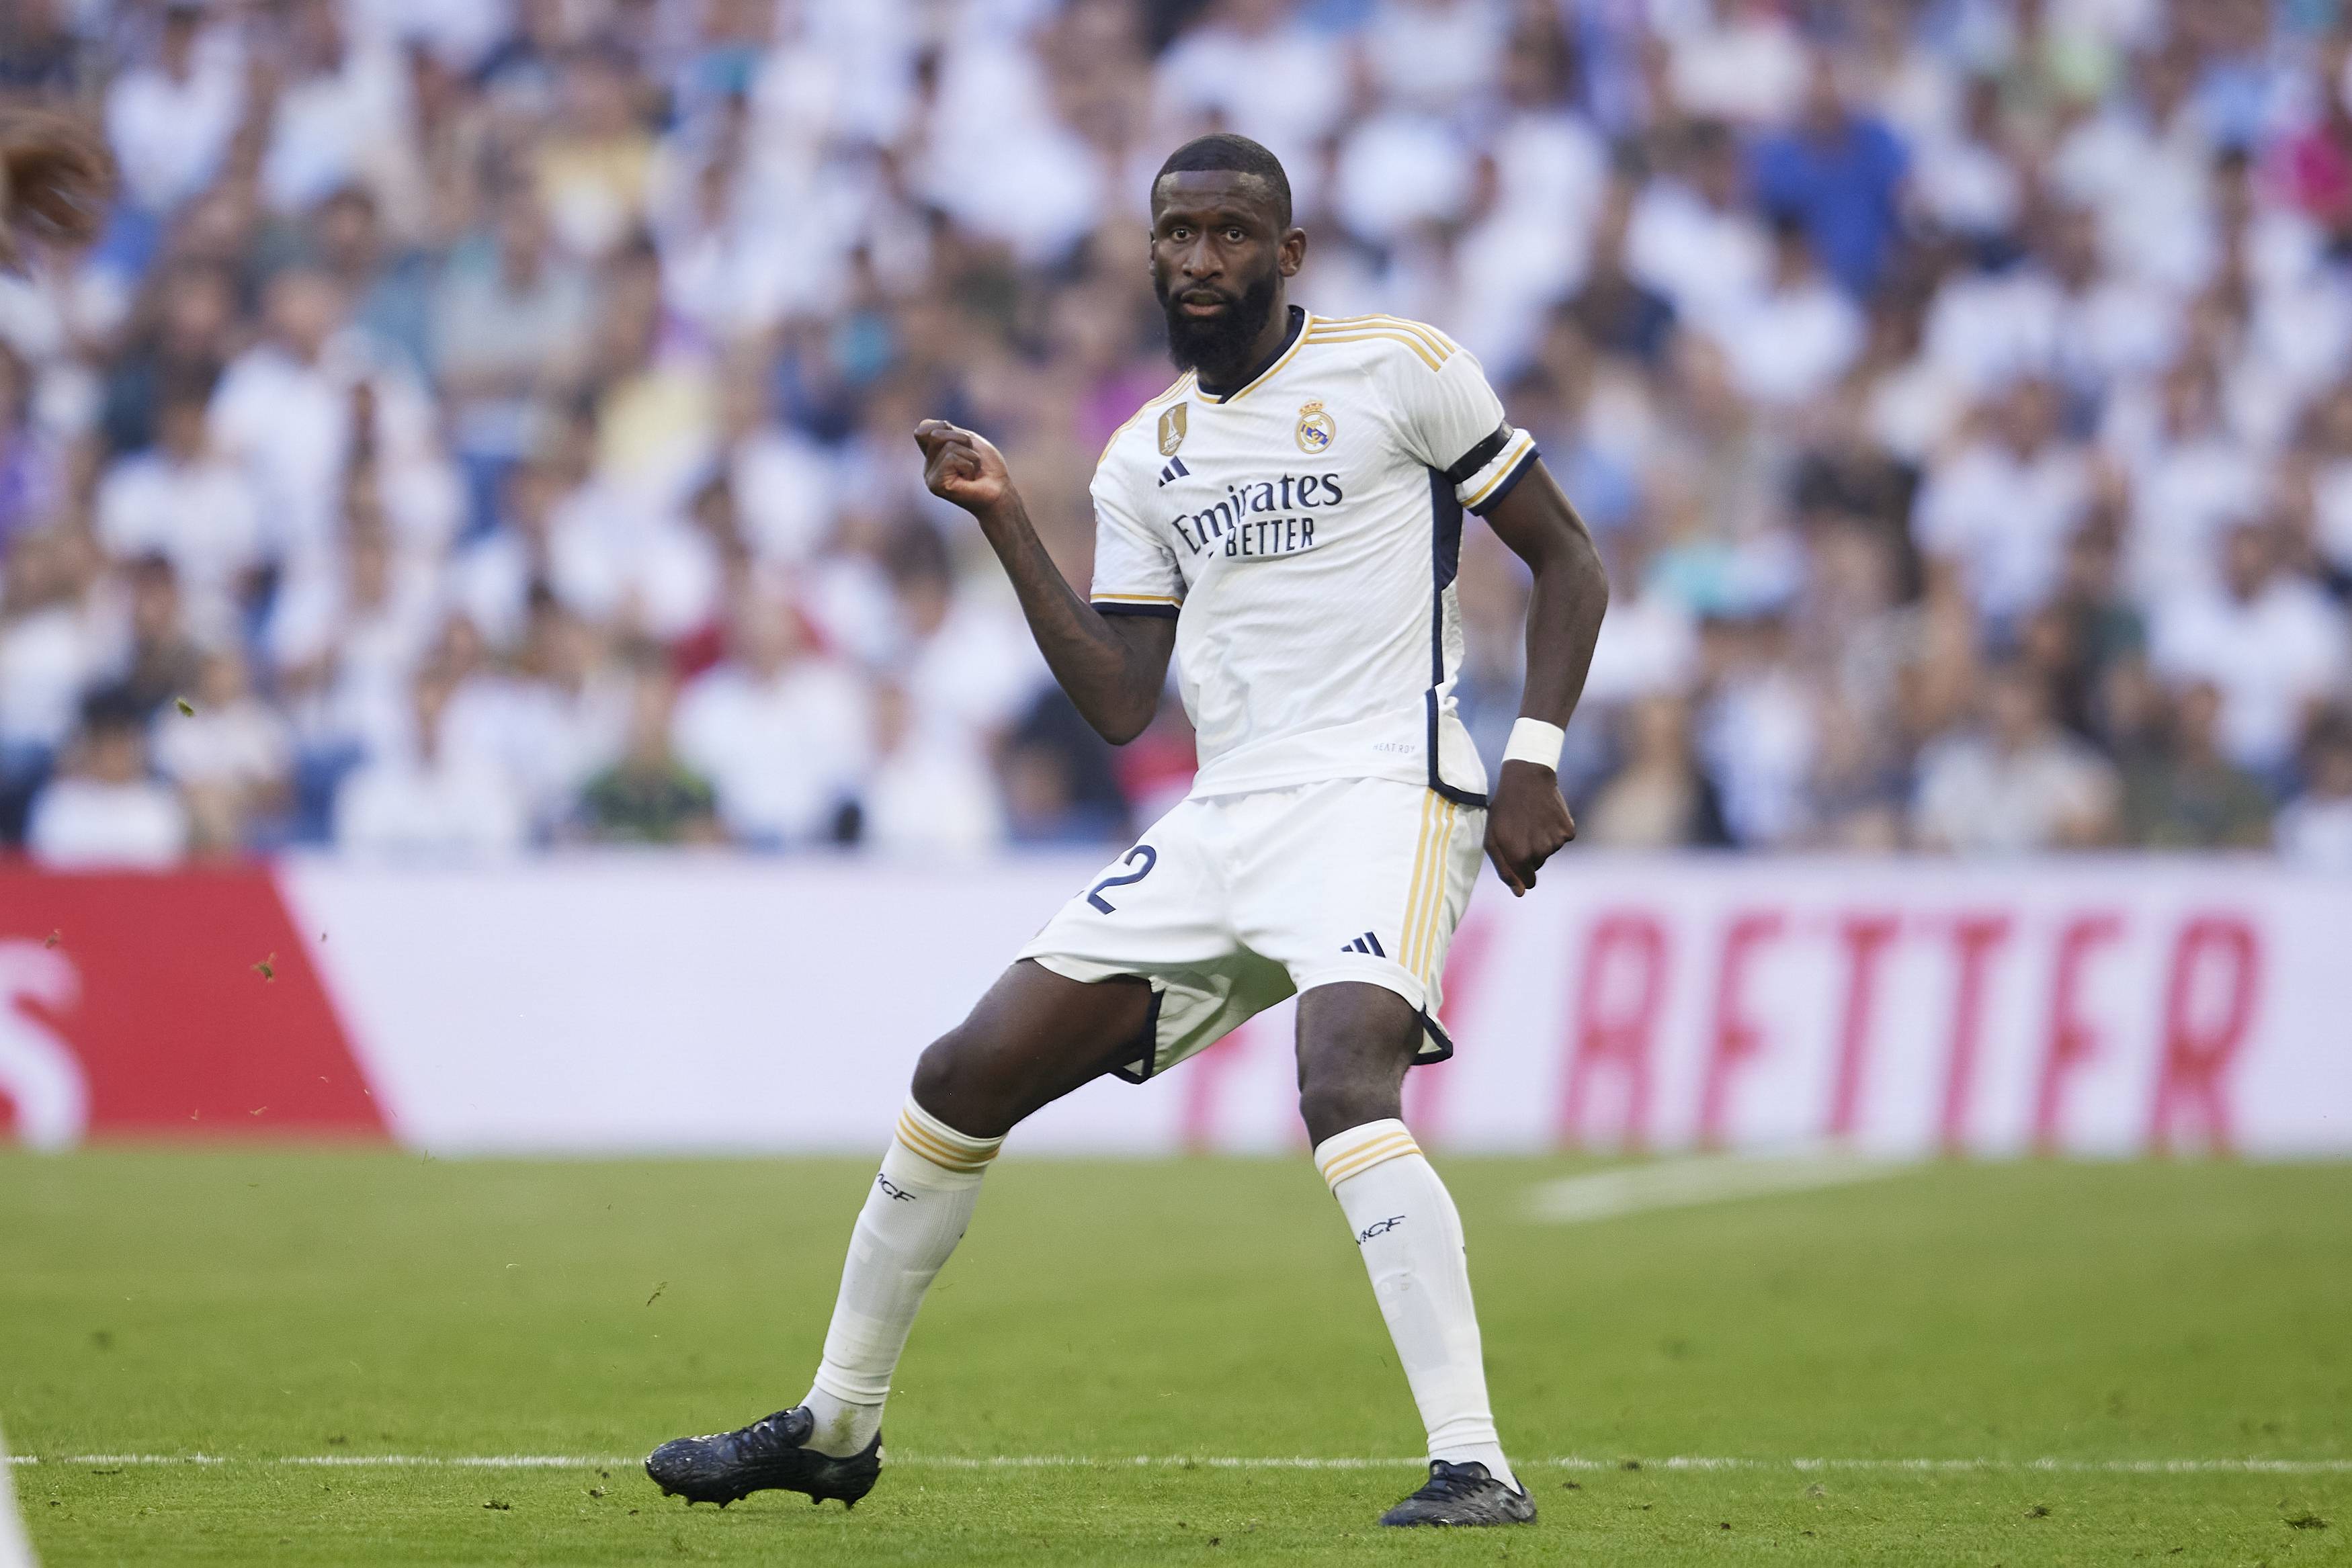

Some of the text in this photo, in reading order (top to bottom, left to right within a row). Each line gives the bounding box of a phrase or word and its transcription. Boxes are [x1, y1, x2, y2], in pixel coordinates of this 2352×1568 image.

[1172, 472, 1343, 554] Emirates
[1225, 517, 1314, 557] BETTER
[1074, 844, 1157, 915] 2
